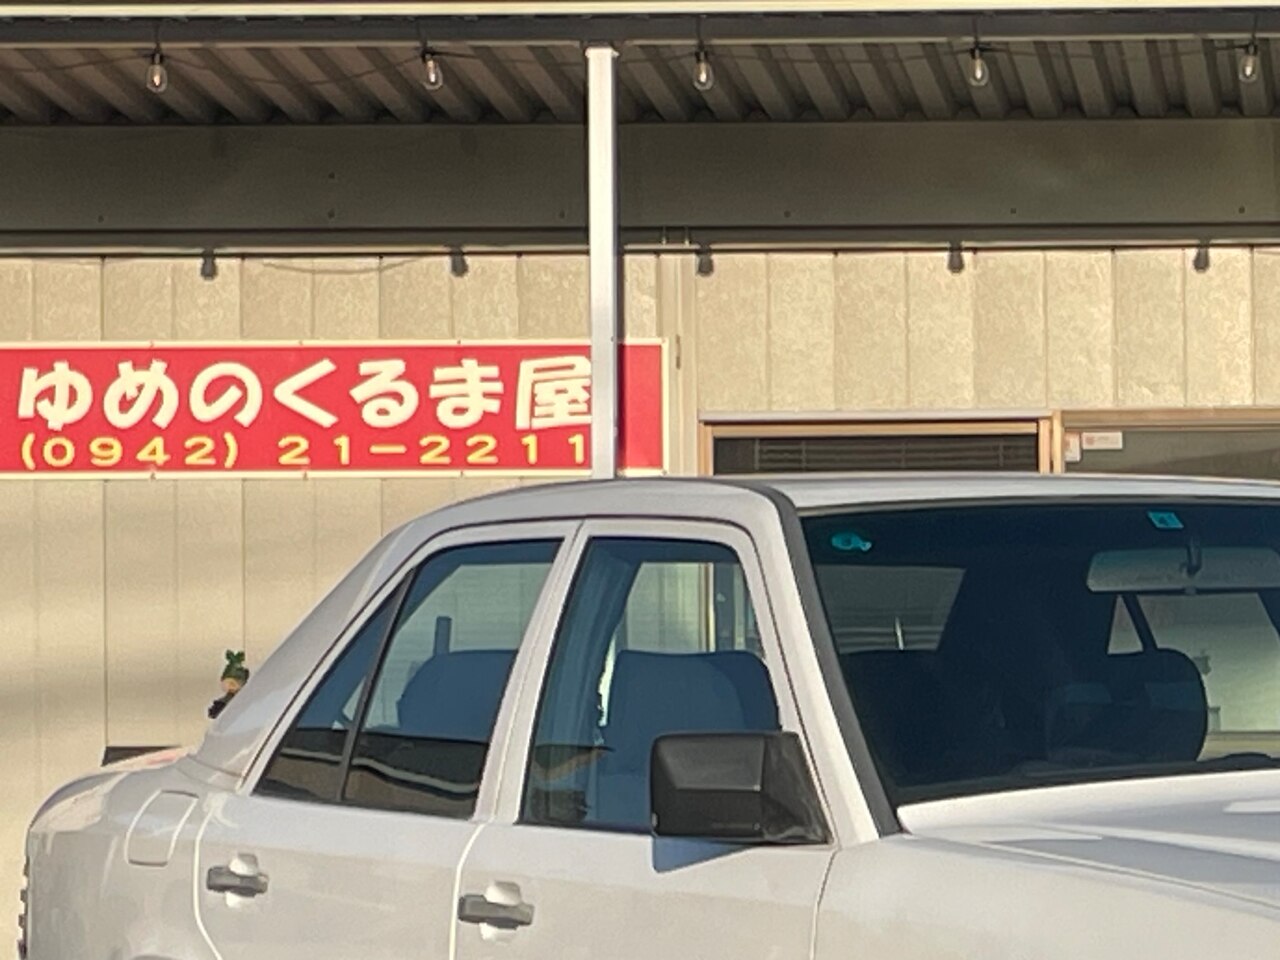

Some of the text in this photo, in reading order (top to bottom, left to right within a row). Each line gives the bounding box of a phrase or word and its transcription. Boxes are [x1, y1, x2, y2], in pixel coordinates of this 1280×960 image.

[18, 357, 592, 431] ゆめのくるま屋
[20, 433, 587, 469] (0942) 21-2211
